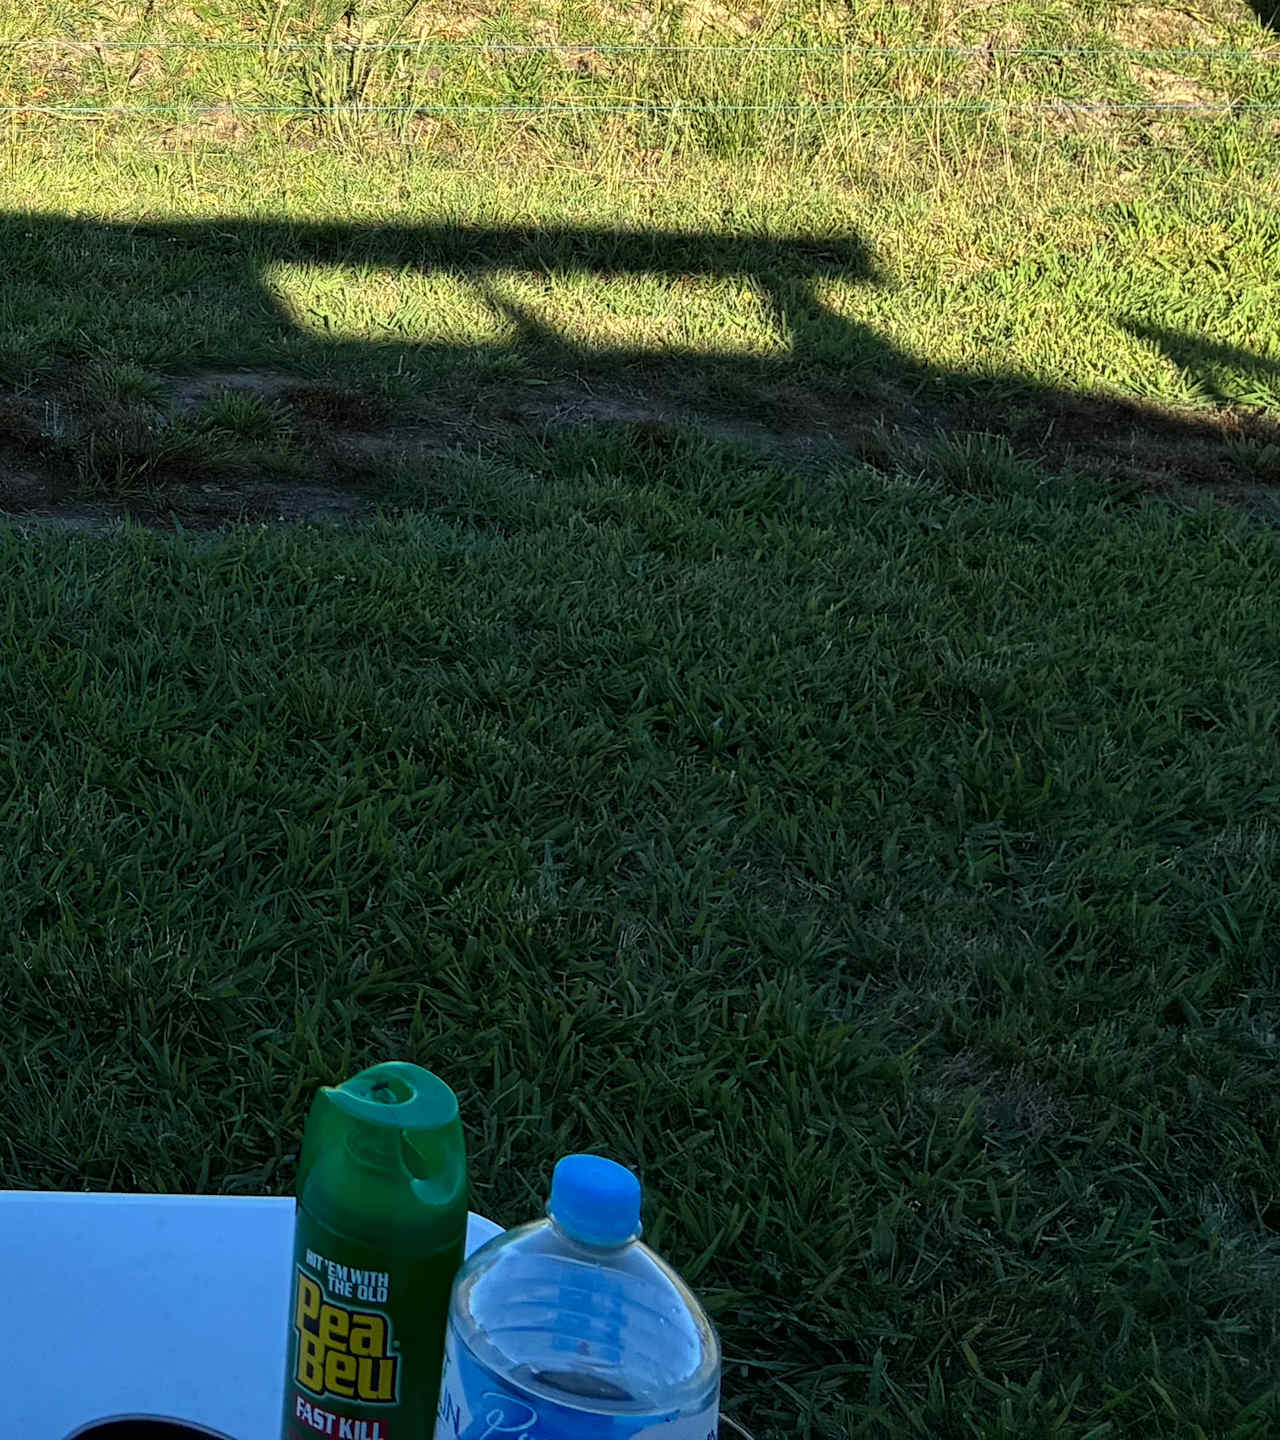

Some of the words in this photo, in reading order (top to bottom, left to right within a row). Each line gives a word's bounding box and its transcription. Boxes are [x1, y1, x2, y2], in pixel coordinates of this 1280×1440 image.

[306, 1248, 323, 1272] HIT
[350, 1267, 389, 1288] WITH
[328, 1275, 353, 1298] THE
[357, 1284, 388, 1303] OLD
[296, 1273, 385, 1358] Pea
[297, 1331, 393, 1400] Beu
[296, 1395, 336, 1434] FAST
[339, 1416, 385, 1440] KILL
